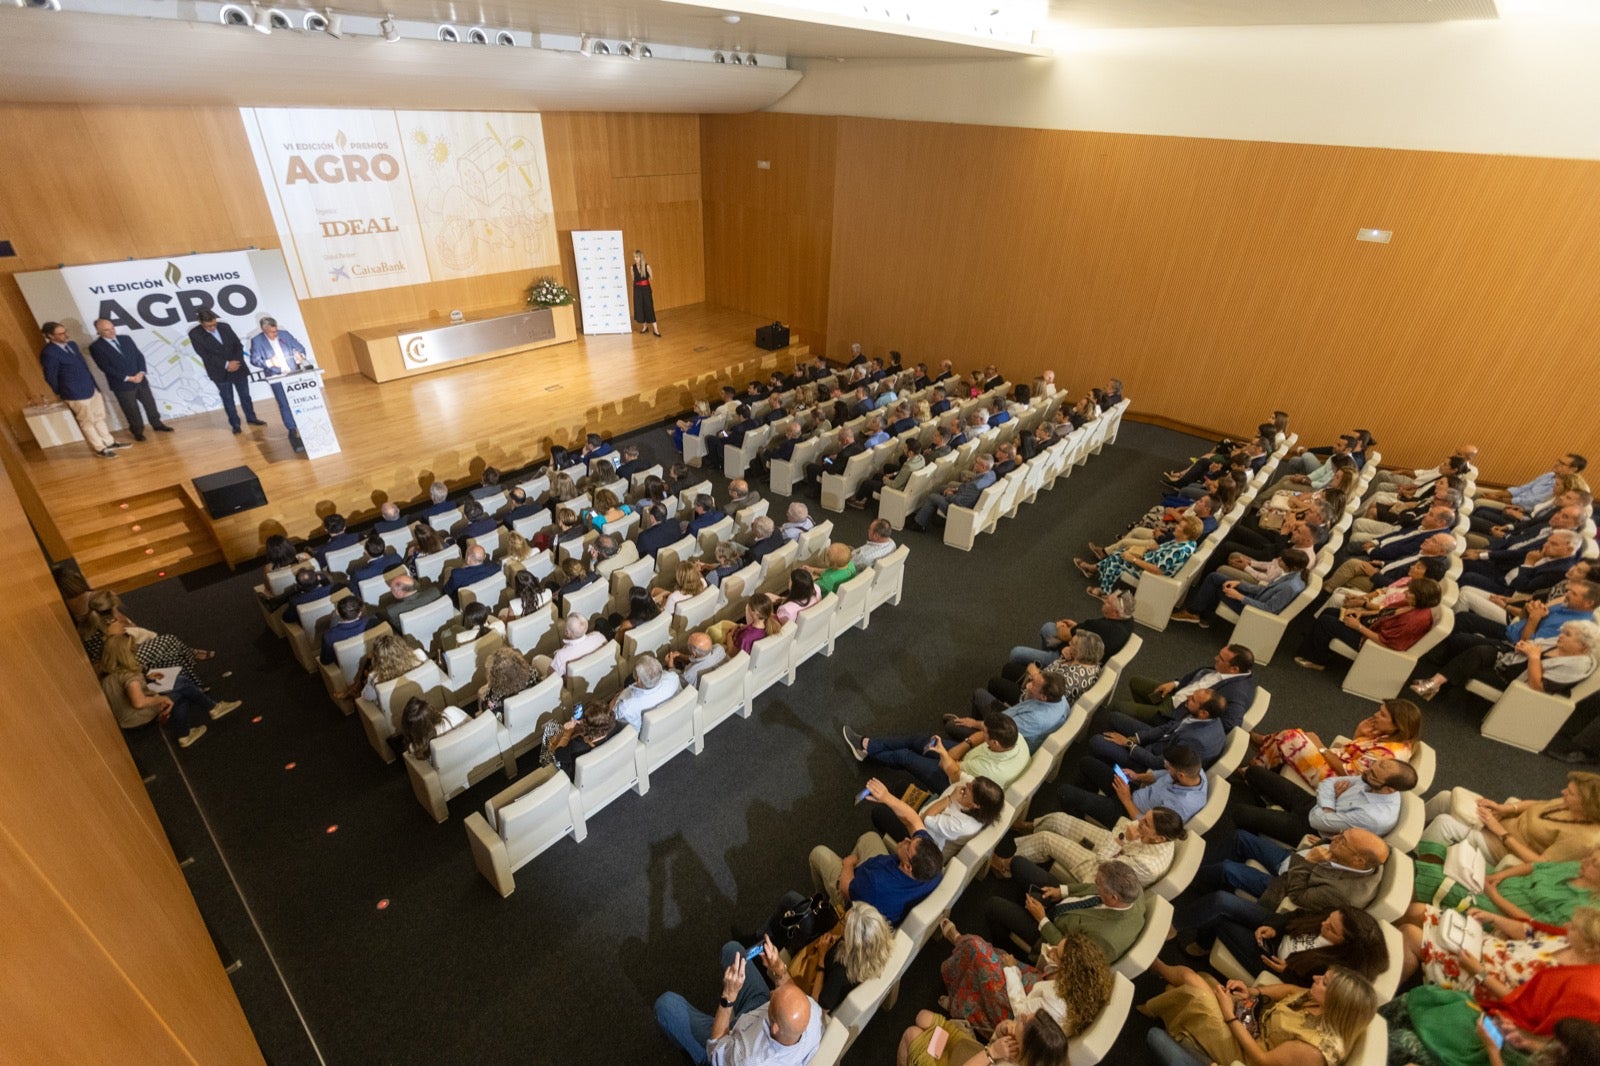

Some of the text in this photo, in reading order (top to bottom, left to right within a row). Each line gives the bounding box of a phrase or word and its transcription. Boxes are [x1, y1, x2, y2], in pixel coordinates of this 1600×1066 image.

[283, 141, 389, 151] VI EDICIÓN PREMIOS
[286, 153, 400, 185] AGRO
[319, 217, 399, 238] IDEAL
[351, 260, 406, 276] CaixaBank
[89, 271, 241, 295] VI EDICIÓN PREMIOS
[99, 284, 258, 331] AGRO
[286, 380, 317, 393] AGRO
